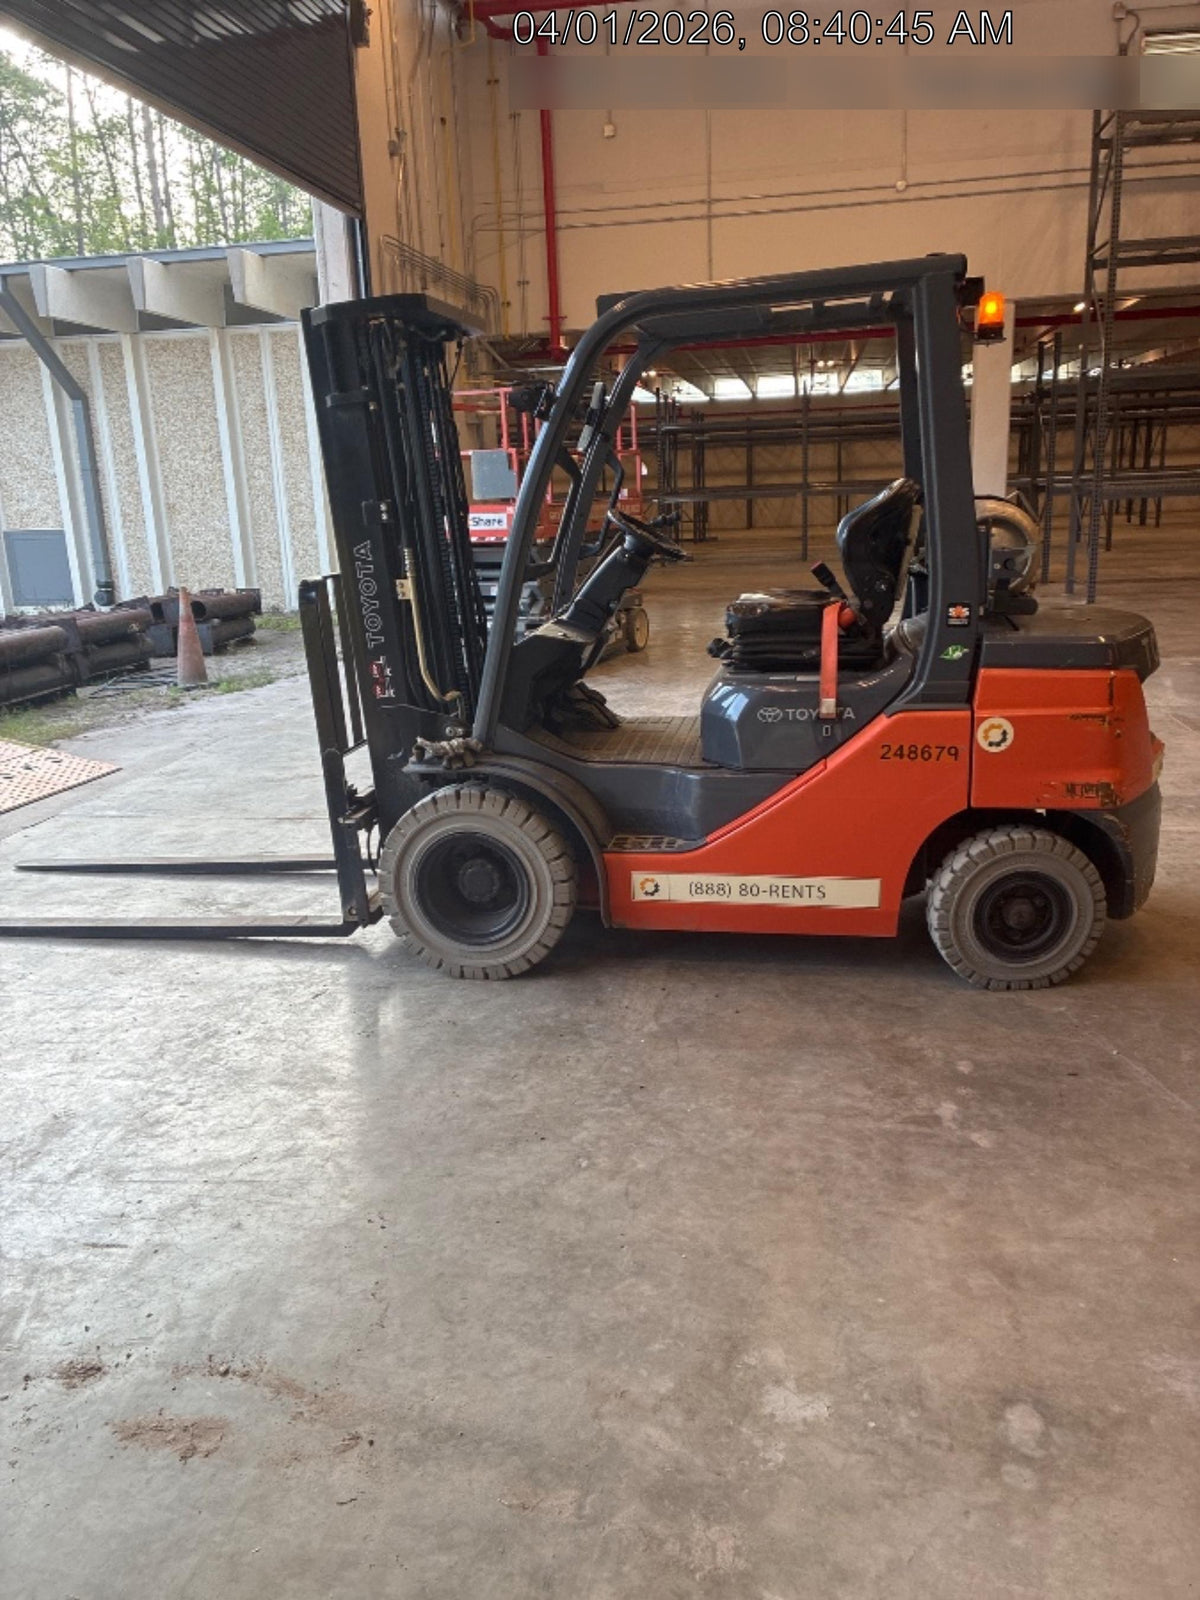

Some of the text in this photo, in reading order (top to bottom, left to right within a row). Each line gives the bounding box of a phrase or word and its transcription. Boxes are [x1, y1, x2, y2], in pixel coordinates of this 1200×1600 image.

[353, 539, 385, 649] TOYOTA
[785, 706, 856, 721] TOYTA
[880, 743, 960, 762] 248679
[688, 881, 827, 900] (888) 80-RENTS
